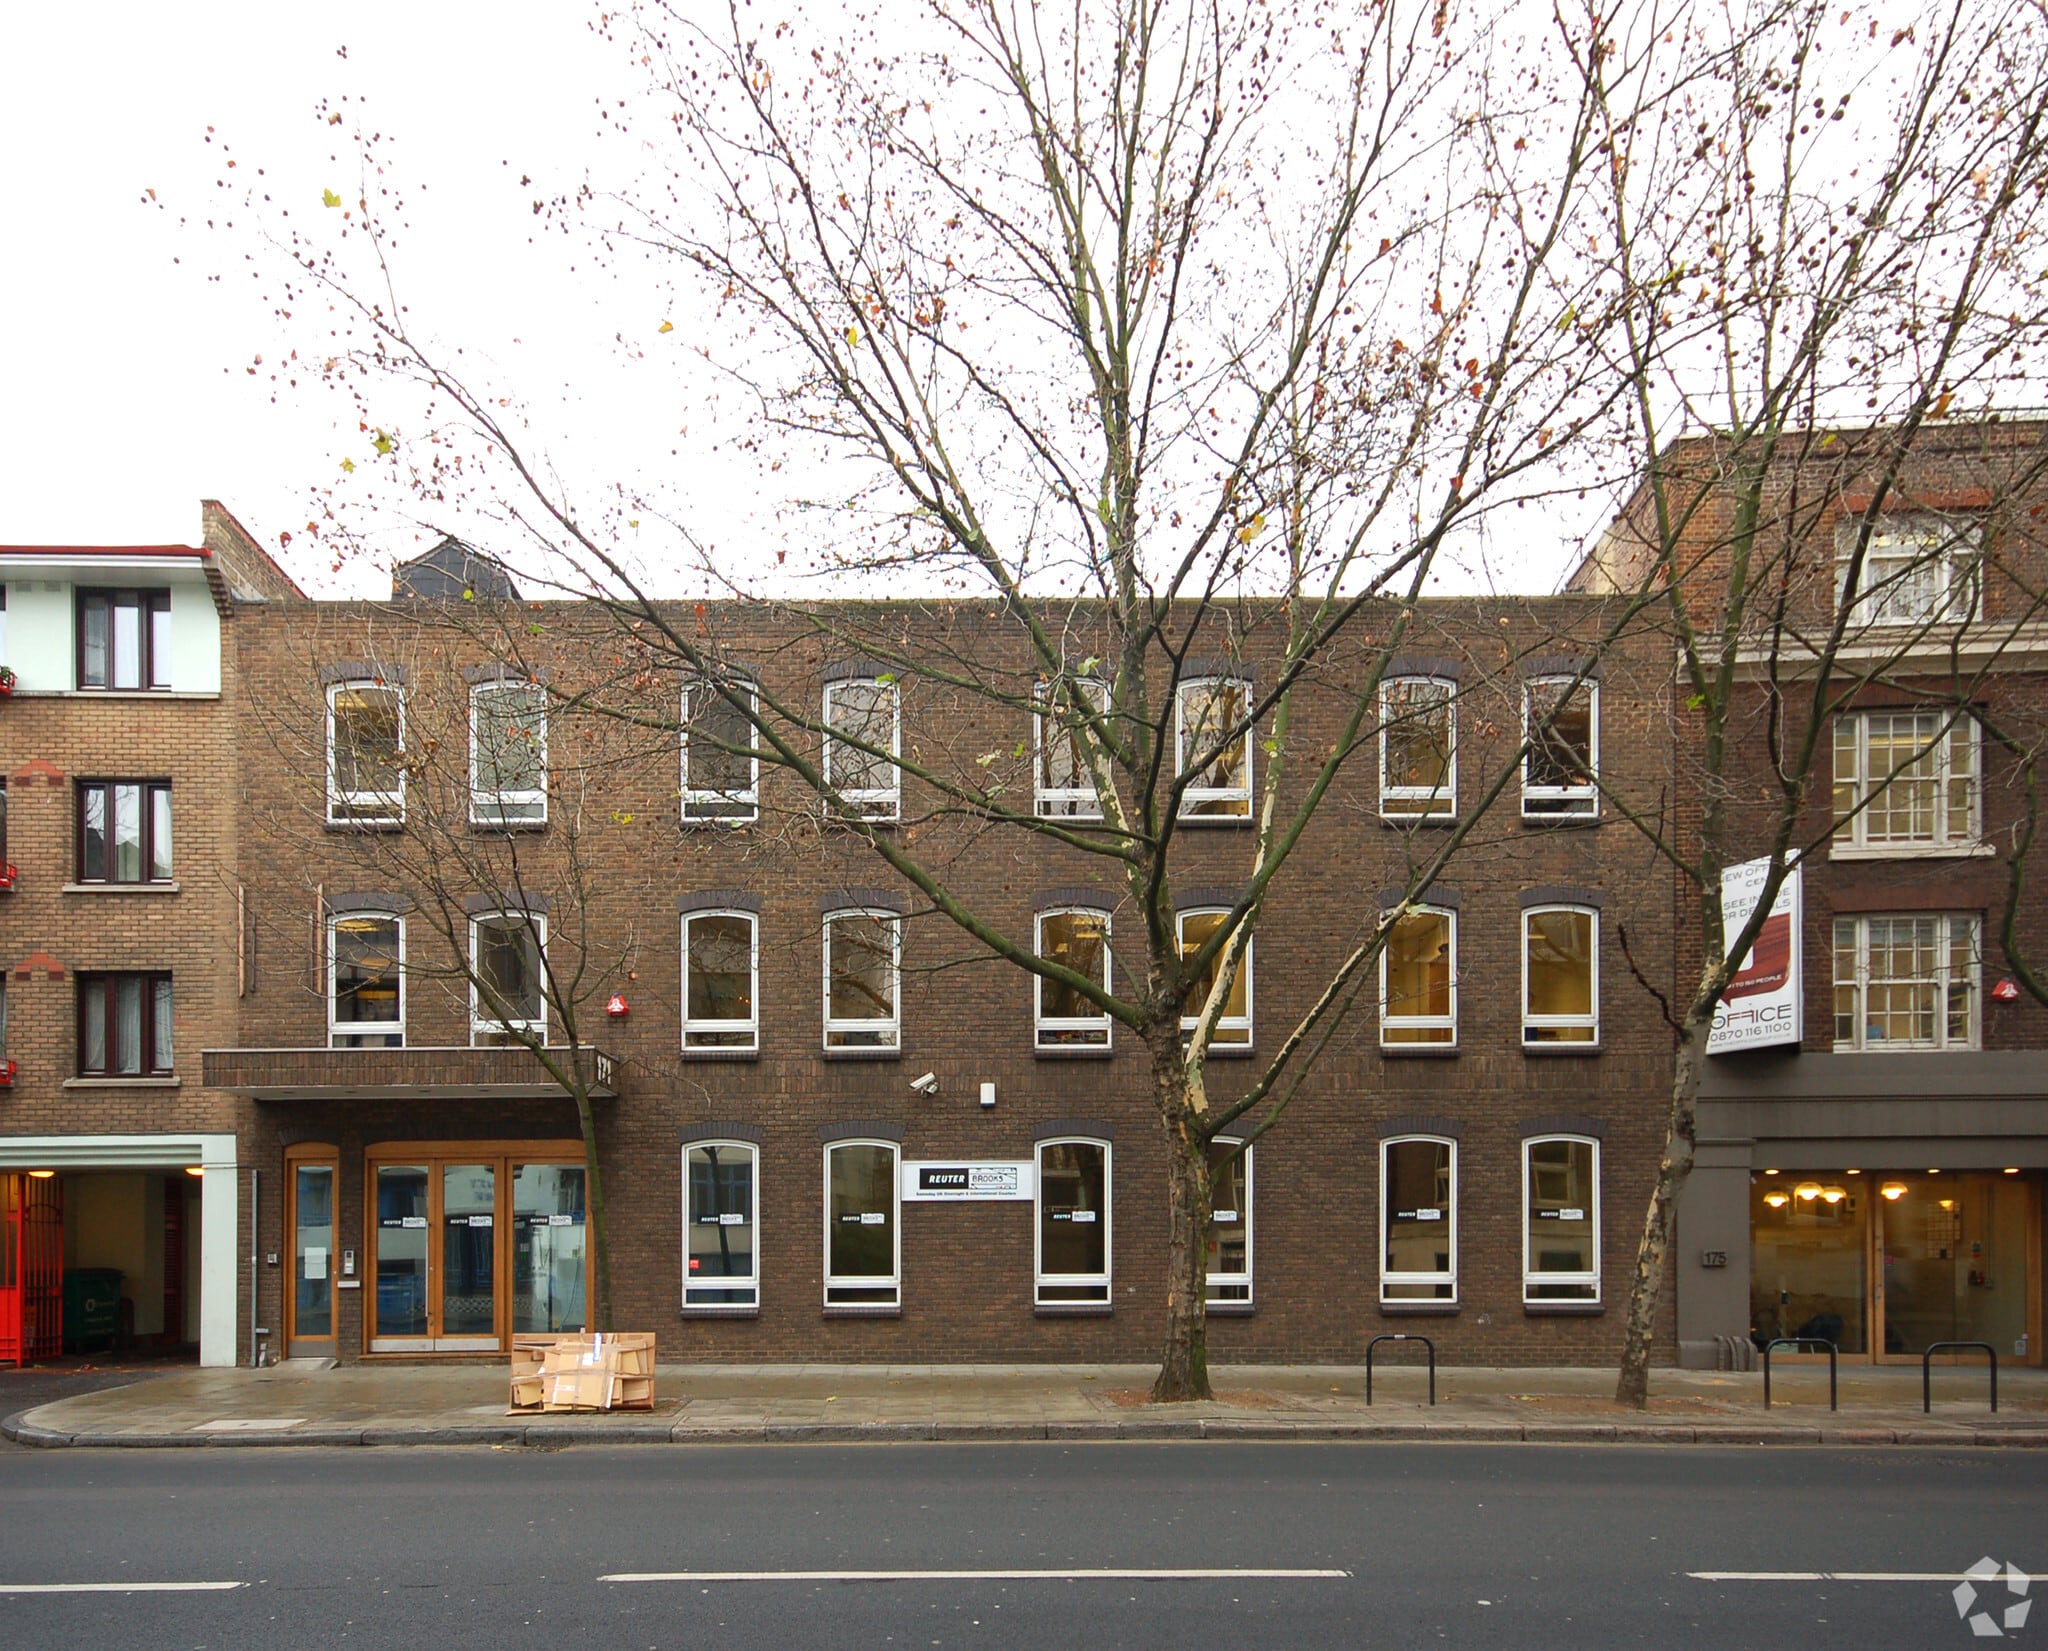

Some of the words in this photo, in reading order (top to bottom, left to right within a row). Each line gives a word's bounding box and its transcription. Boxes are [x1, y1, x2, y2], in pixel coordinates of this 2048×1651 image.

[1722, 872, 1743, 882] EW
[1723, 898, 1746, 910] SEE
[1739, 898, 1791, 918] DELS
[1711, 1004, 1792, 1030] OFFICE
[1710, 1029, 1743, 1042] 0870
[1745, 1026, 1762, 1037] 116
[1765, 1021, 1792, 1034] 1100
[929, 1175, 966, 1183] REUTER
[1705, 1251, 1727, 1264] 175
